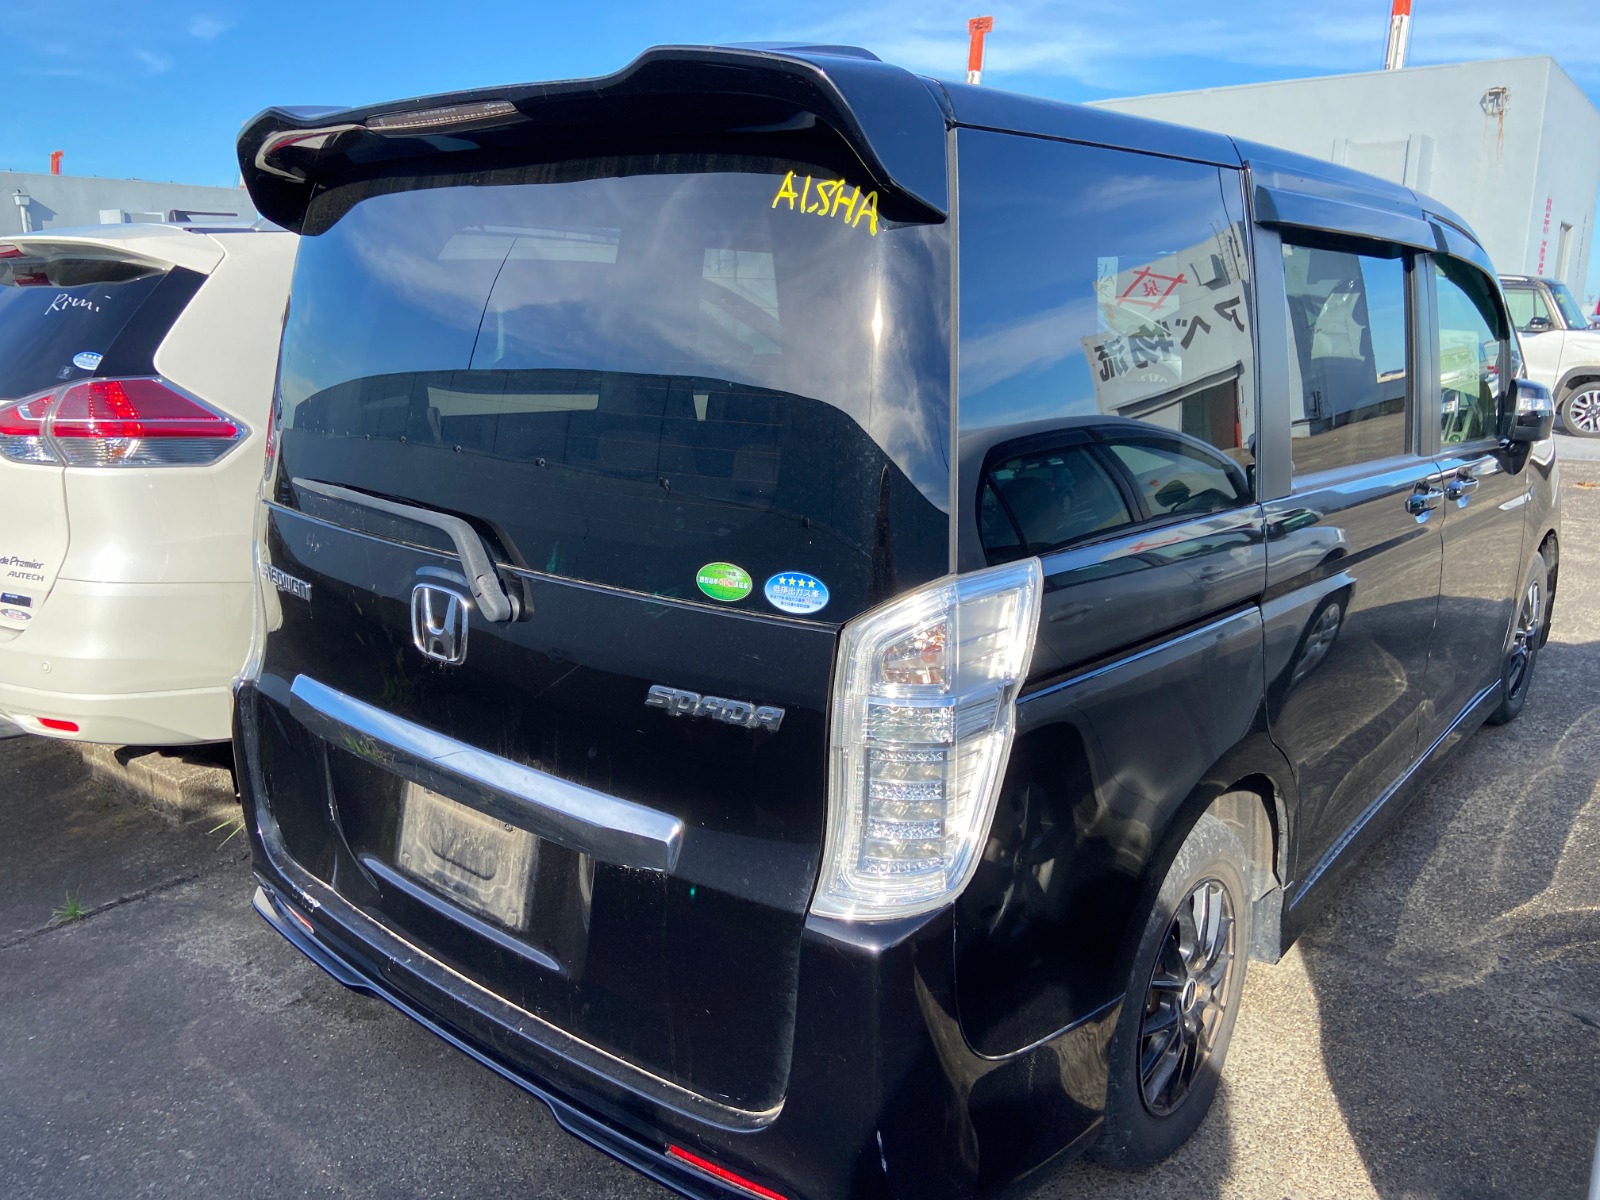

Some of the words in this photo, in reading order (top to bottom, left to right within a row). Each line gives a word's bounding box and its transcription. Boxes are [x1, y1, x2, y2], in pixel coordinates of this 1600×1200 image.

[772, 170, 878, 236] AISHA
[7, 570, 44, 582] AUTECH
[9, 556, 44, 569] Premier
[645, 685, 785, 732] SPADA
